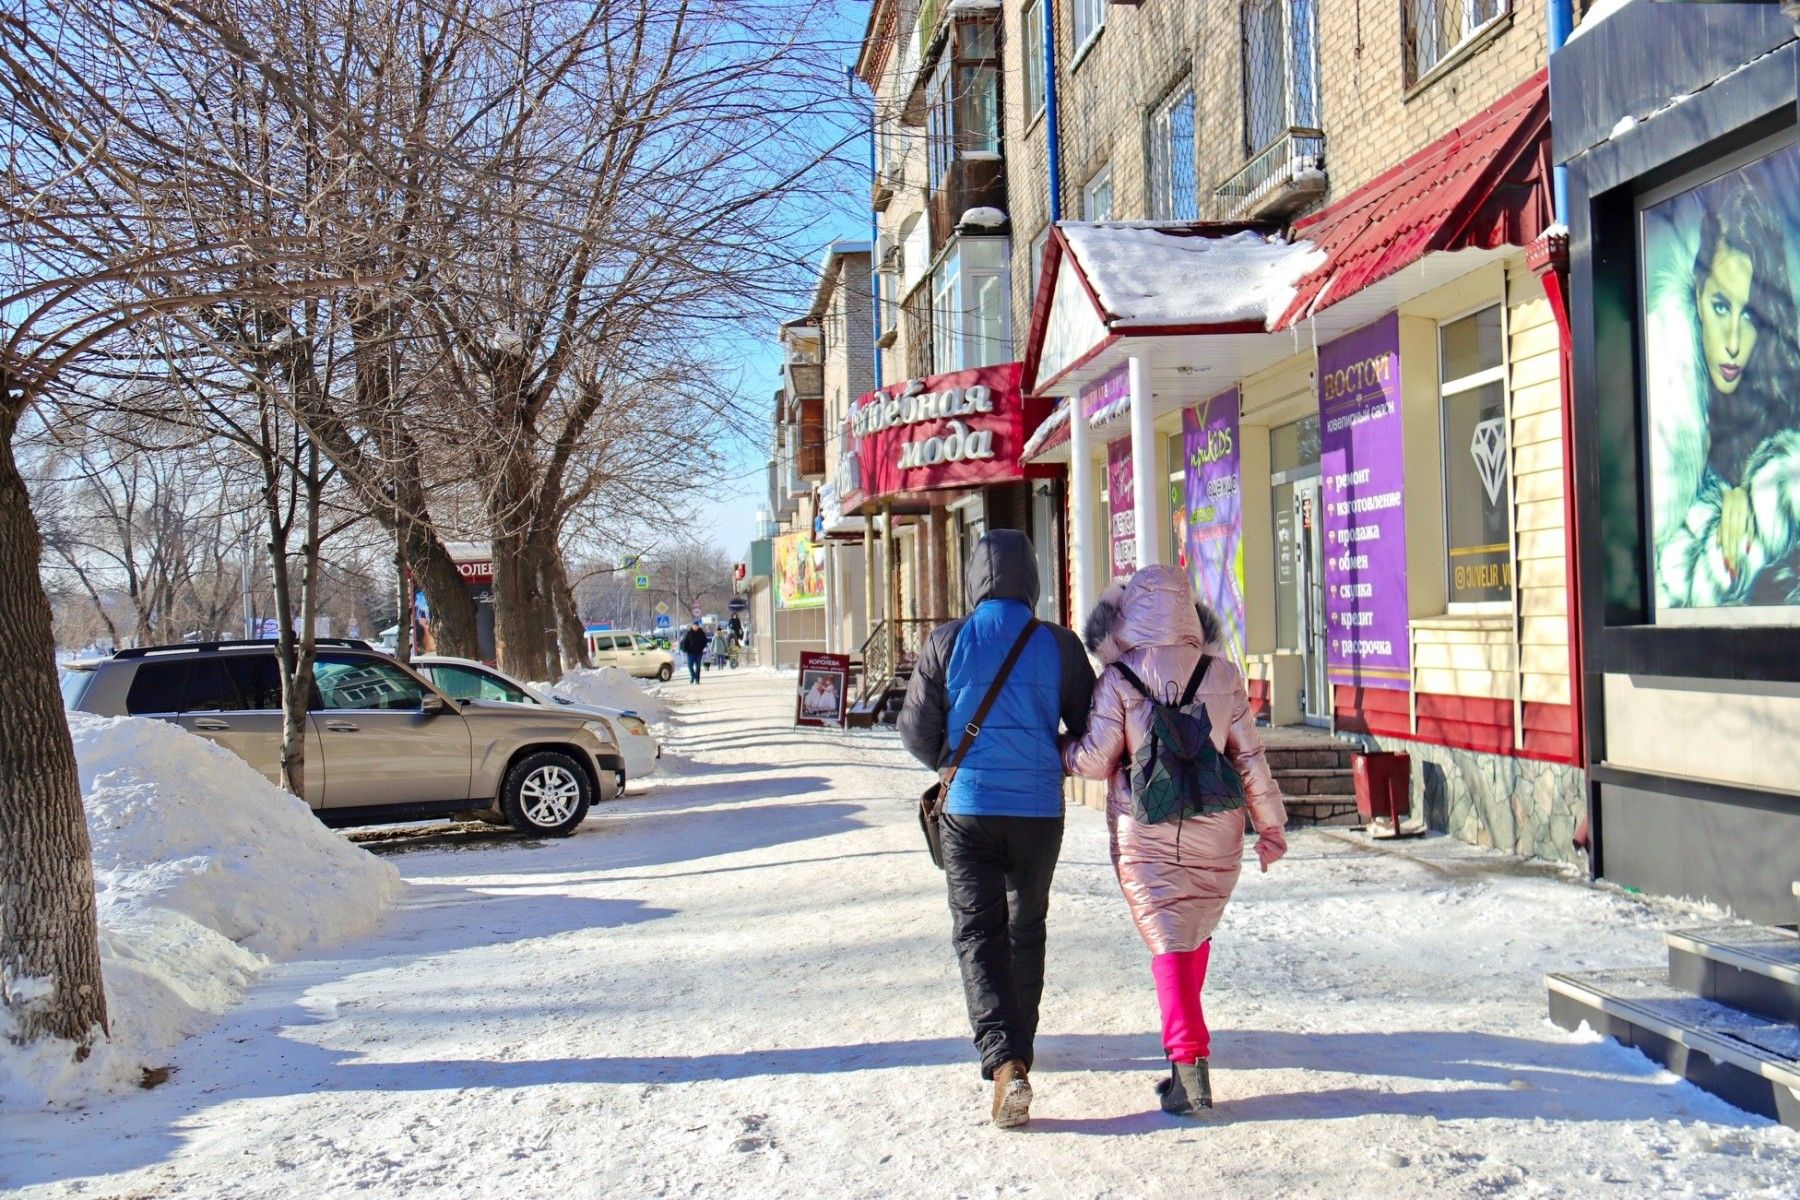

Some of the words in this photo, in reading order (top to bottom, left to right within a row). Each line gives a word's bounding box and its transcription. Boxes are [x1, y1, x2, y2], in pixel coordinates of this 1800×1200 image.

[1325, 351, 1391, 400] ВОСТОРГ
[1327, 404, 1370, 432] ювелирный
[1371, 400, 1395, 420] салон
[897, 420, 995, 469] мода
[1335, 468, 1370, 492] ремонт
[1336, 490, 1401, 517] изготовление
[1337, 523, 1380, 547] продажа
[1338, 549, 1368, 571] обмен
[1340, 581, 1372, 602] скупка
[1341, 610, 1373, 629] кредит
[1341, 641, 1392, 659] рассрочка
